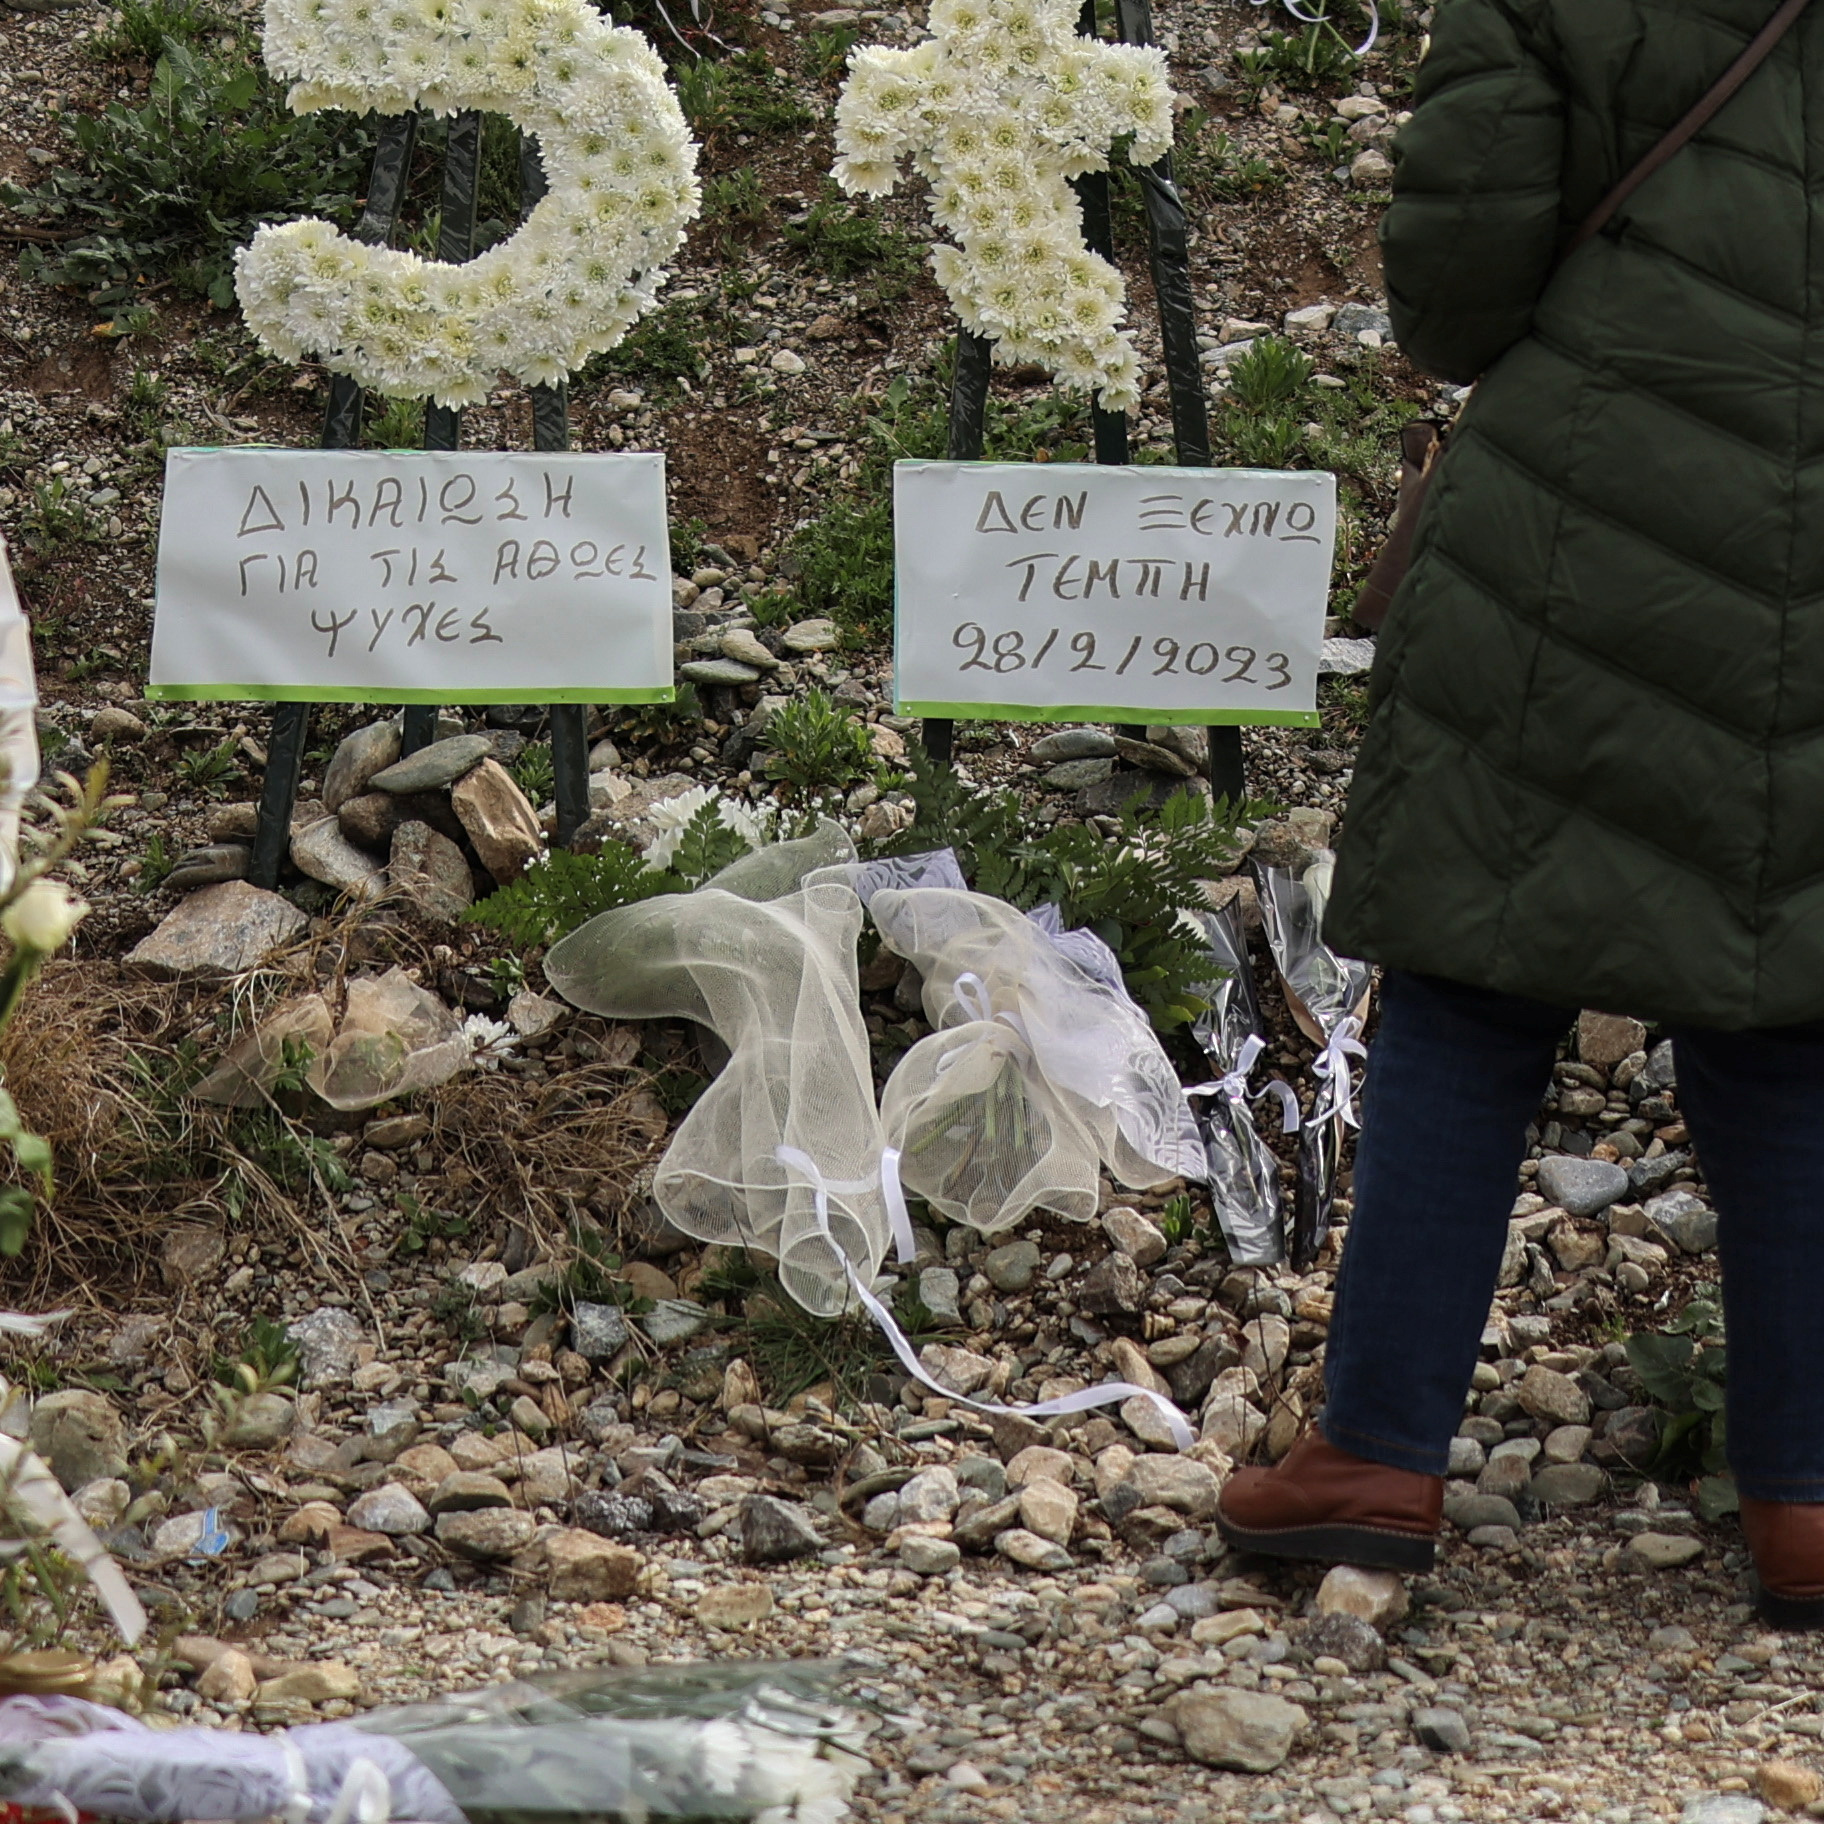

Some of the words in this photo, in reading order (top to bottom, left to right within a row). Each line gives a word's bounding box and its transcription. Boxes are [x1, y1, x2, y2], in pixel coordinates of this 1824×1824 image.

[237, 472, 575, 538] ΔΙΚΑΙΩΣΗ
[975, 490, 1088, 534] ΔΕΝ
[1138, 495, 1321, 544] ΞΕΧΝΩ
[238, 548, 319, 596] ΓΙΑ
[369, 547, 458, 588] ΤΙΣ
[492, 539, 658, 585] ΑΘΩΕΣ
[1005, 552, 1210, 602] ΤΕΜΠΗ
[311, 600, 504, 657] ΨΥΧΕΣ
[951, 621, 1293, 691] 28/2/2023
